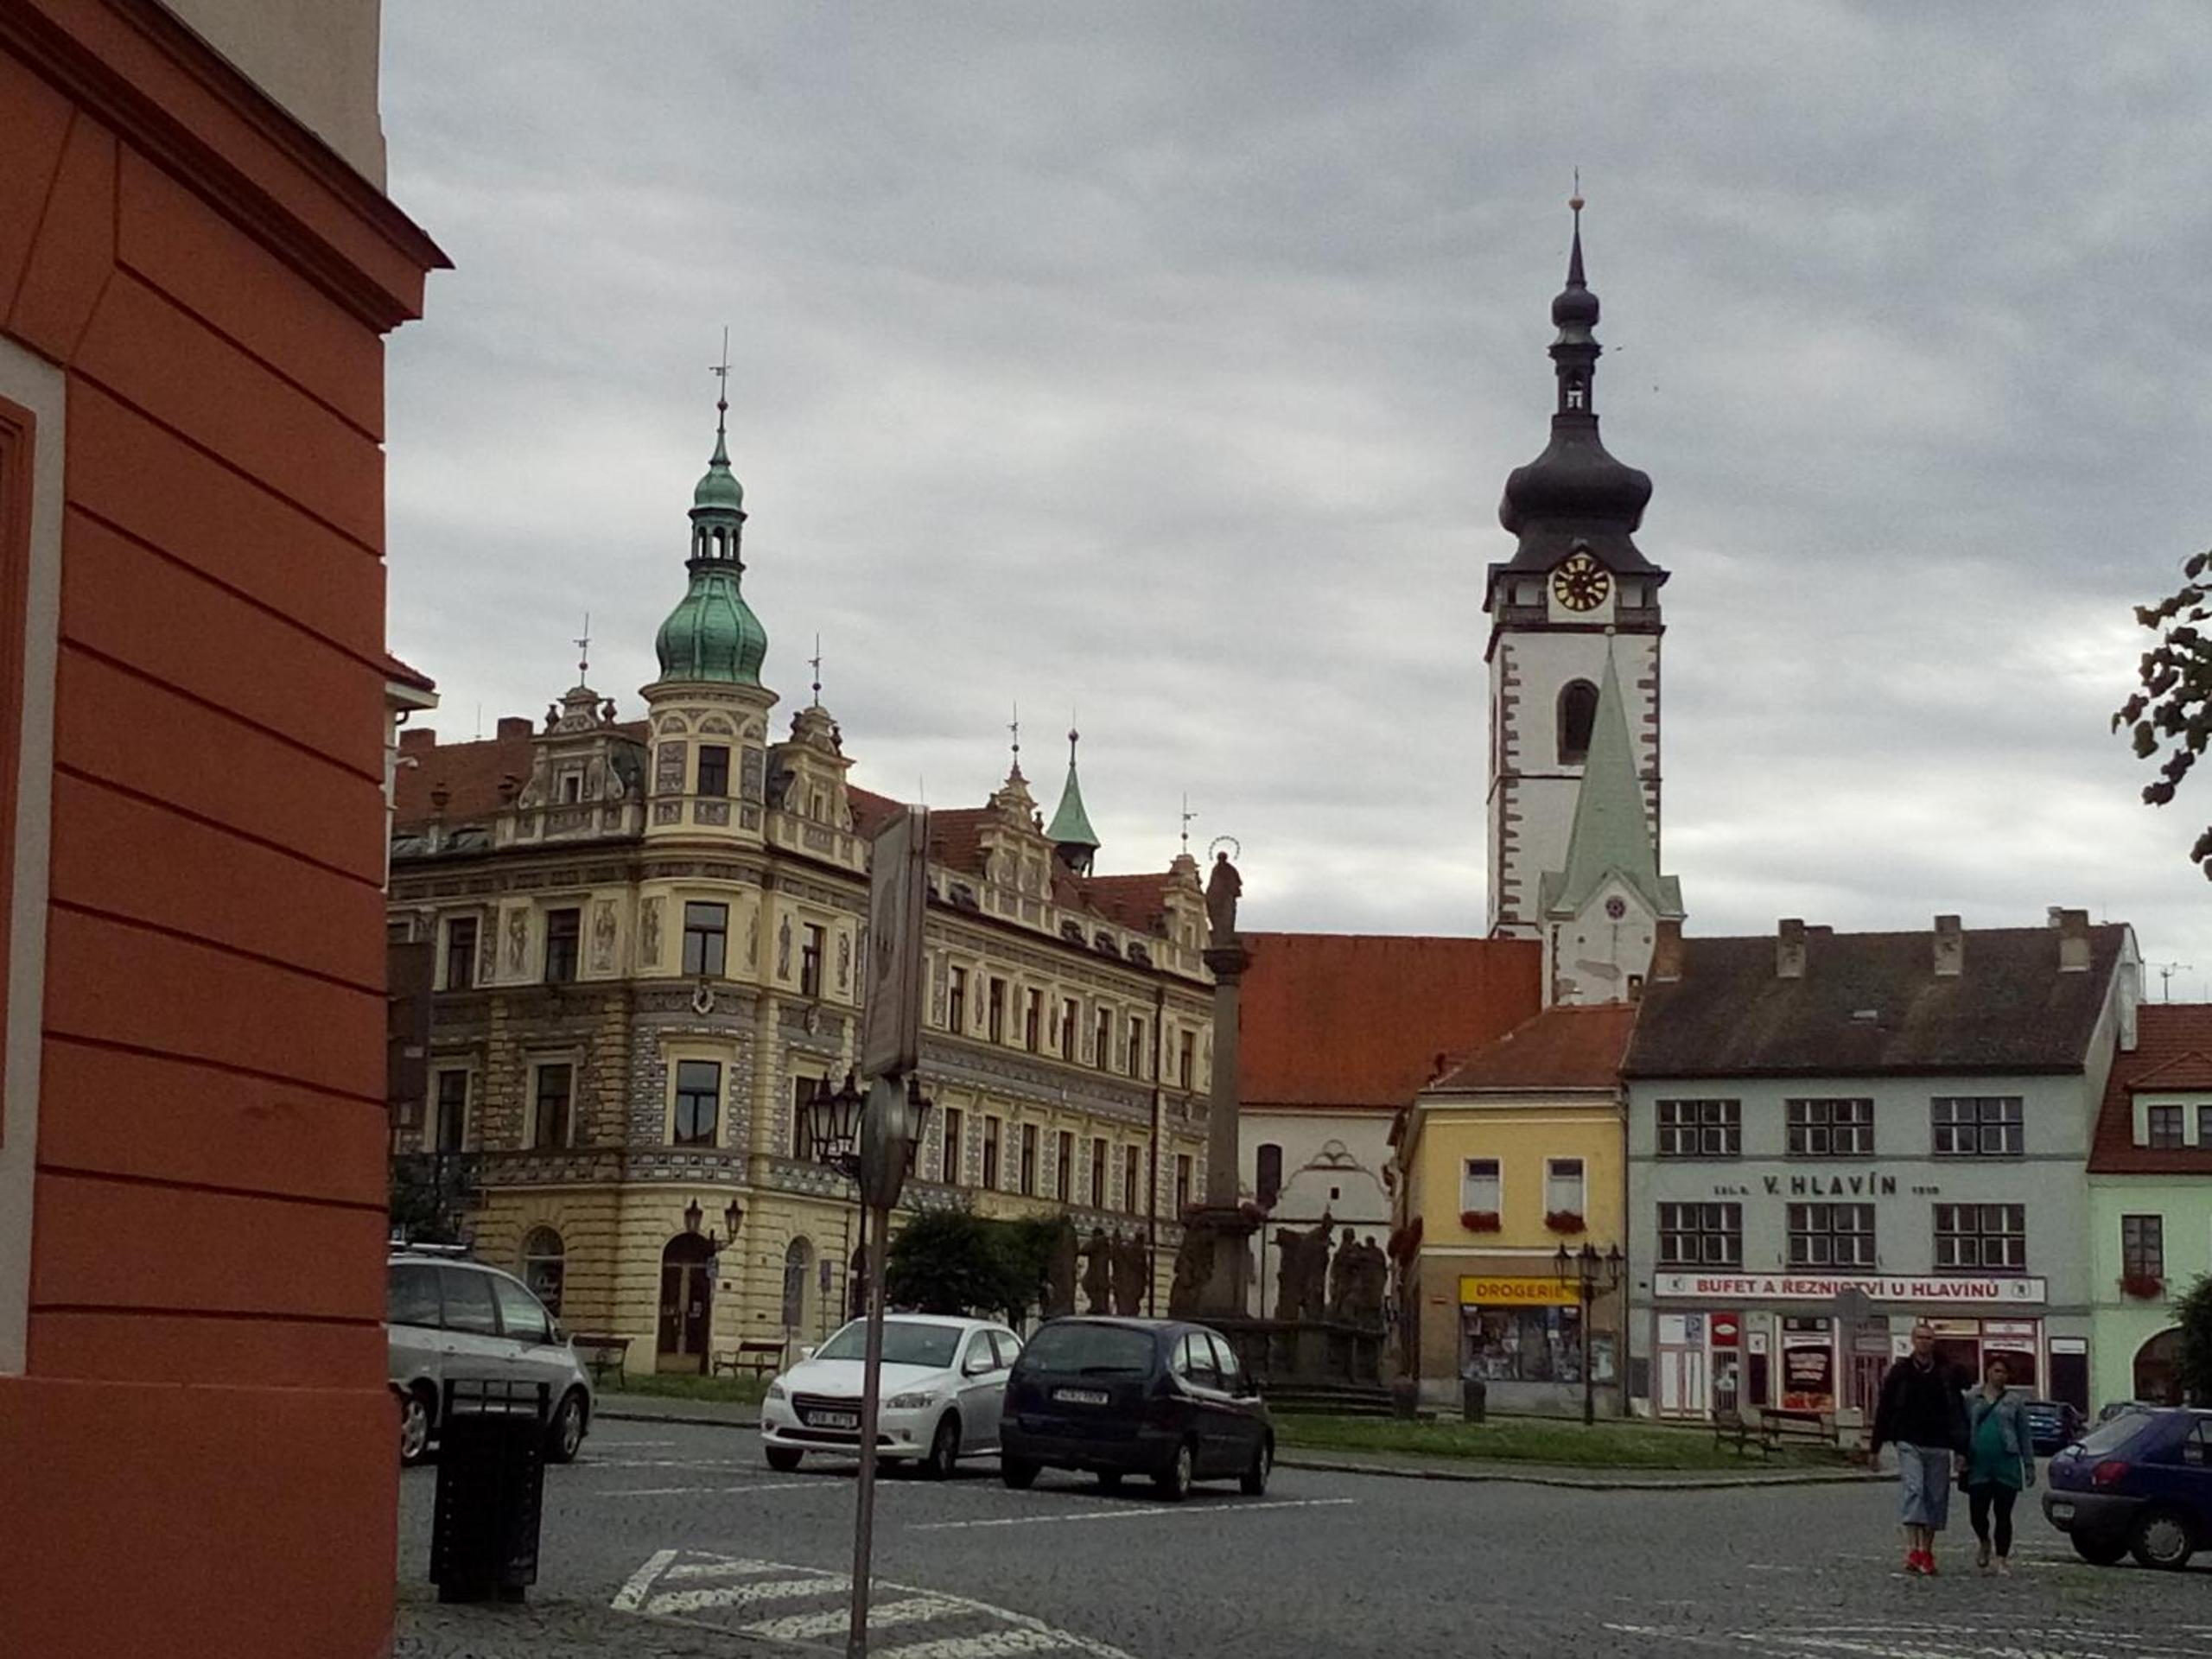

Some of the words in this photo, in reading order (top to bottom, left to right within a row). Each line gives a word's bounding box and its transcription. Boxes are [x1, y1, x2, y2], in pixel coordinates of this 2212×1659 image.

[1764, 1176, 1780, 1194] V.
[1791, 1172, 1897, 1195] HLAVÍN
[1477, 1284, 1564, 1298] DROGERIE
[1697, 1279, 1756, 1293] BUFET
[1763, 1280, 1775, 1294] A
[1891, 1282, 1904, 1296] U
